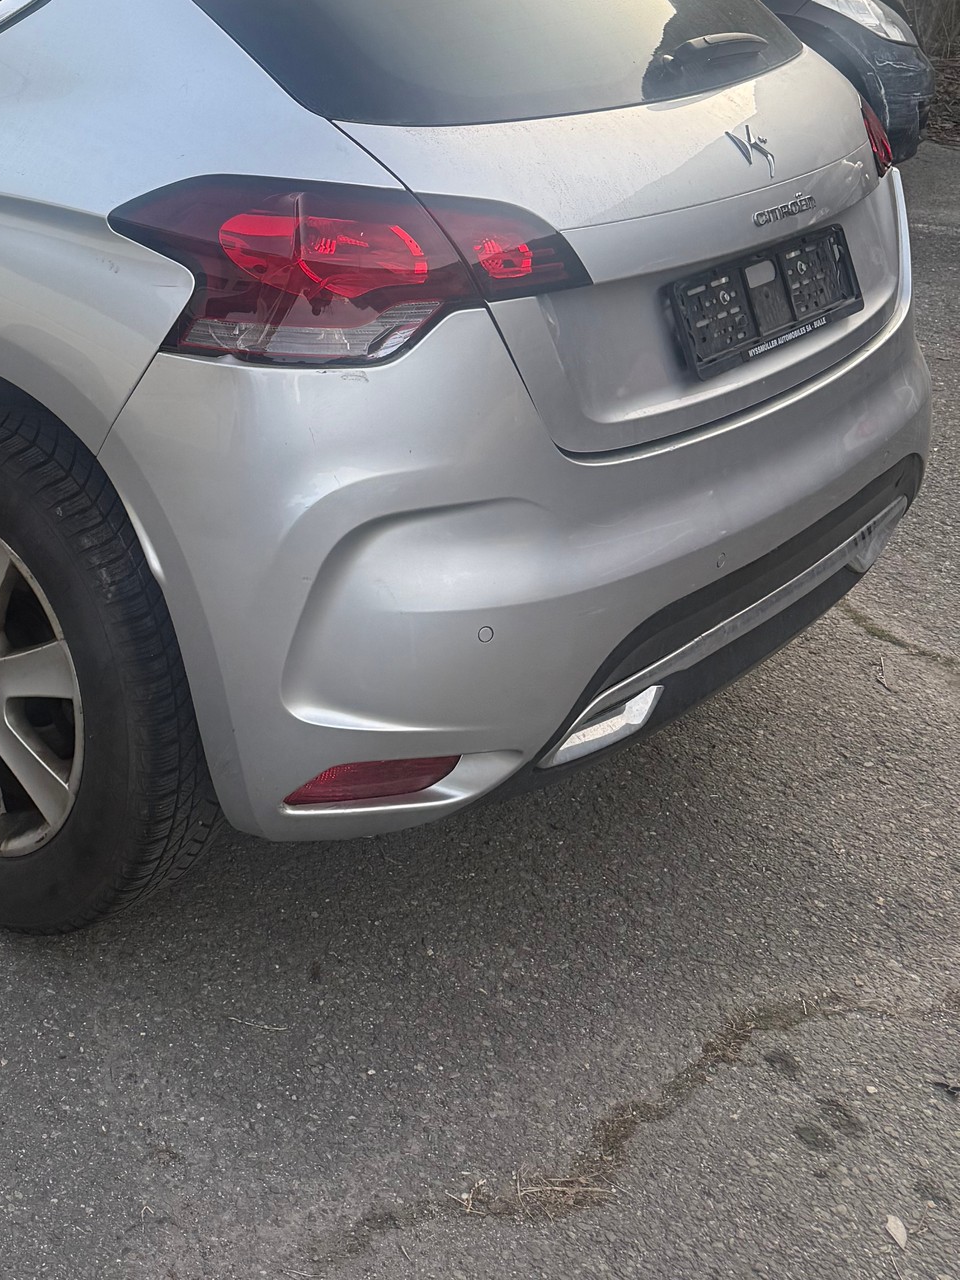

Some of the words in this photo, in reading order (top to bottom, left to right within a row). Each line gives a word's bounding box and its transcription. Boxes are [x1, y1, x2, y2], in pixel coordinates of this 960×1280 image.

[752, 192, 816, 227] CITROËN
[777, 327, 806, 345] AUTOMOBILES
[805, 324, 812, 332] SA
[813, 316, 827, 329] BULLE
